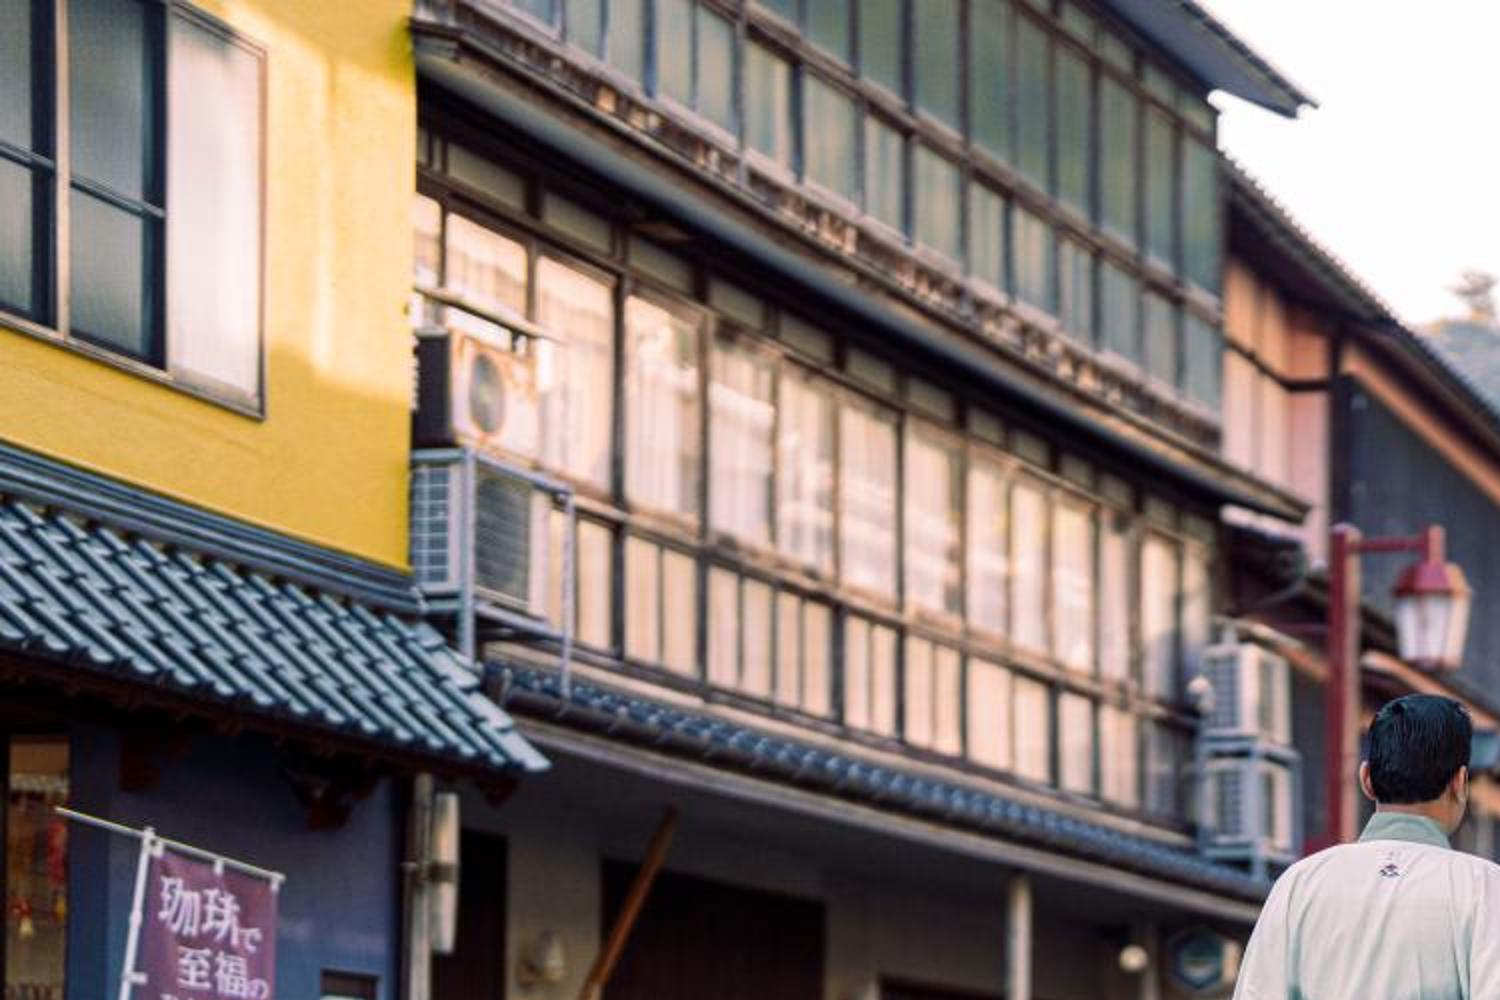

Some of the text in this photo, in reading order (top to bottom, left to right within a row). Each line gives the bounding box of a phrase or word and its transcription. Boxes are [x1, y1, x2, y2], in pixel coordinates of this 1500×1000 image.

[158, 874, 262, 953] 珈琲で
[176, 946, 269, 1000] 至福の
